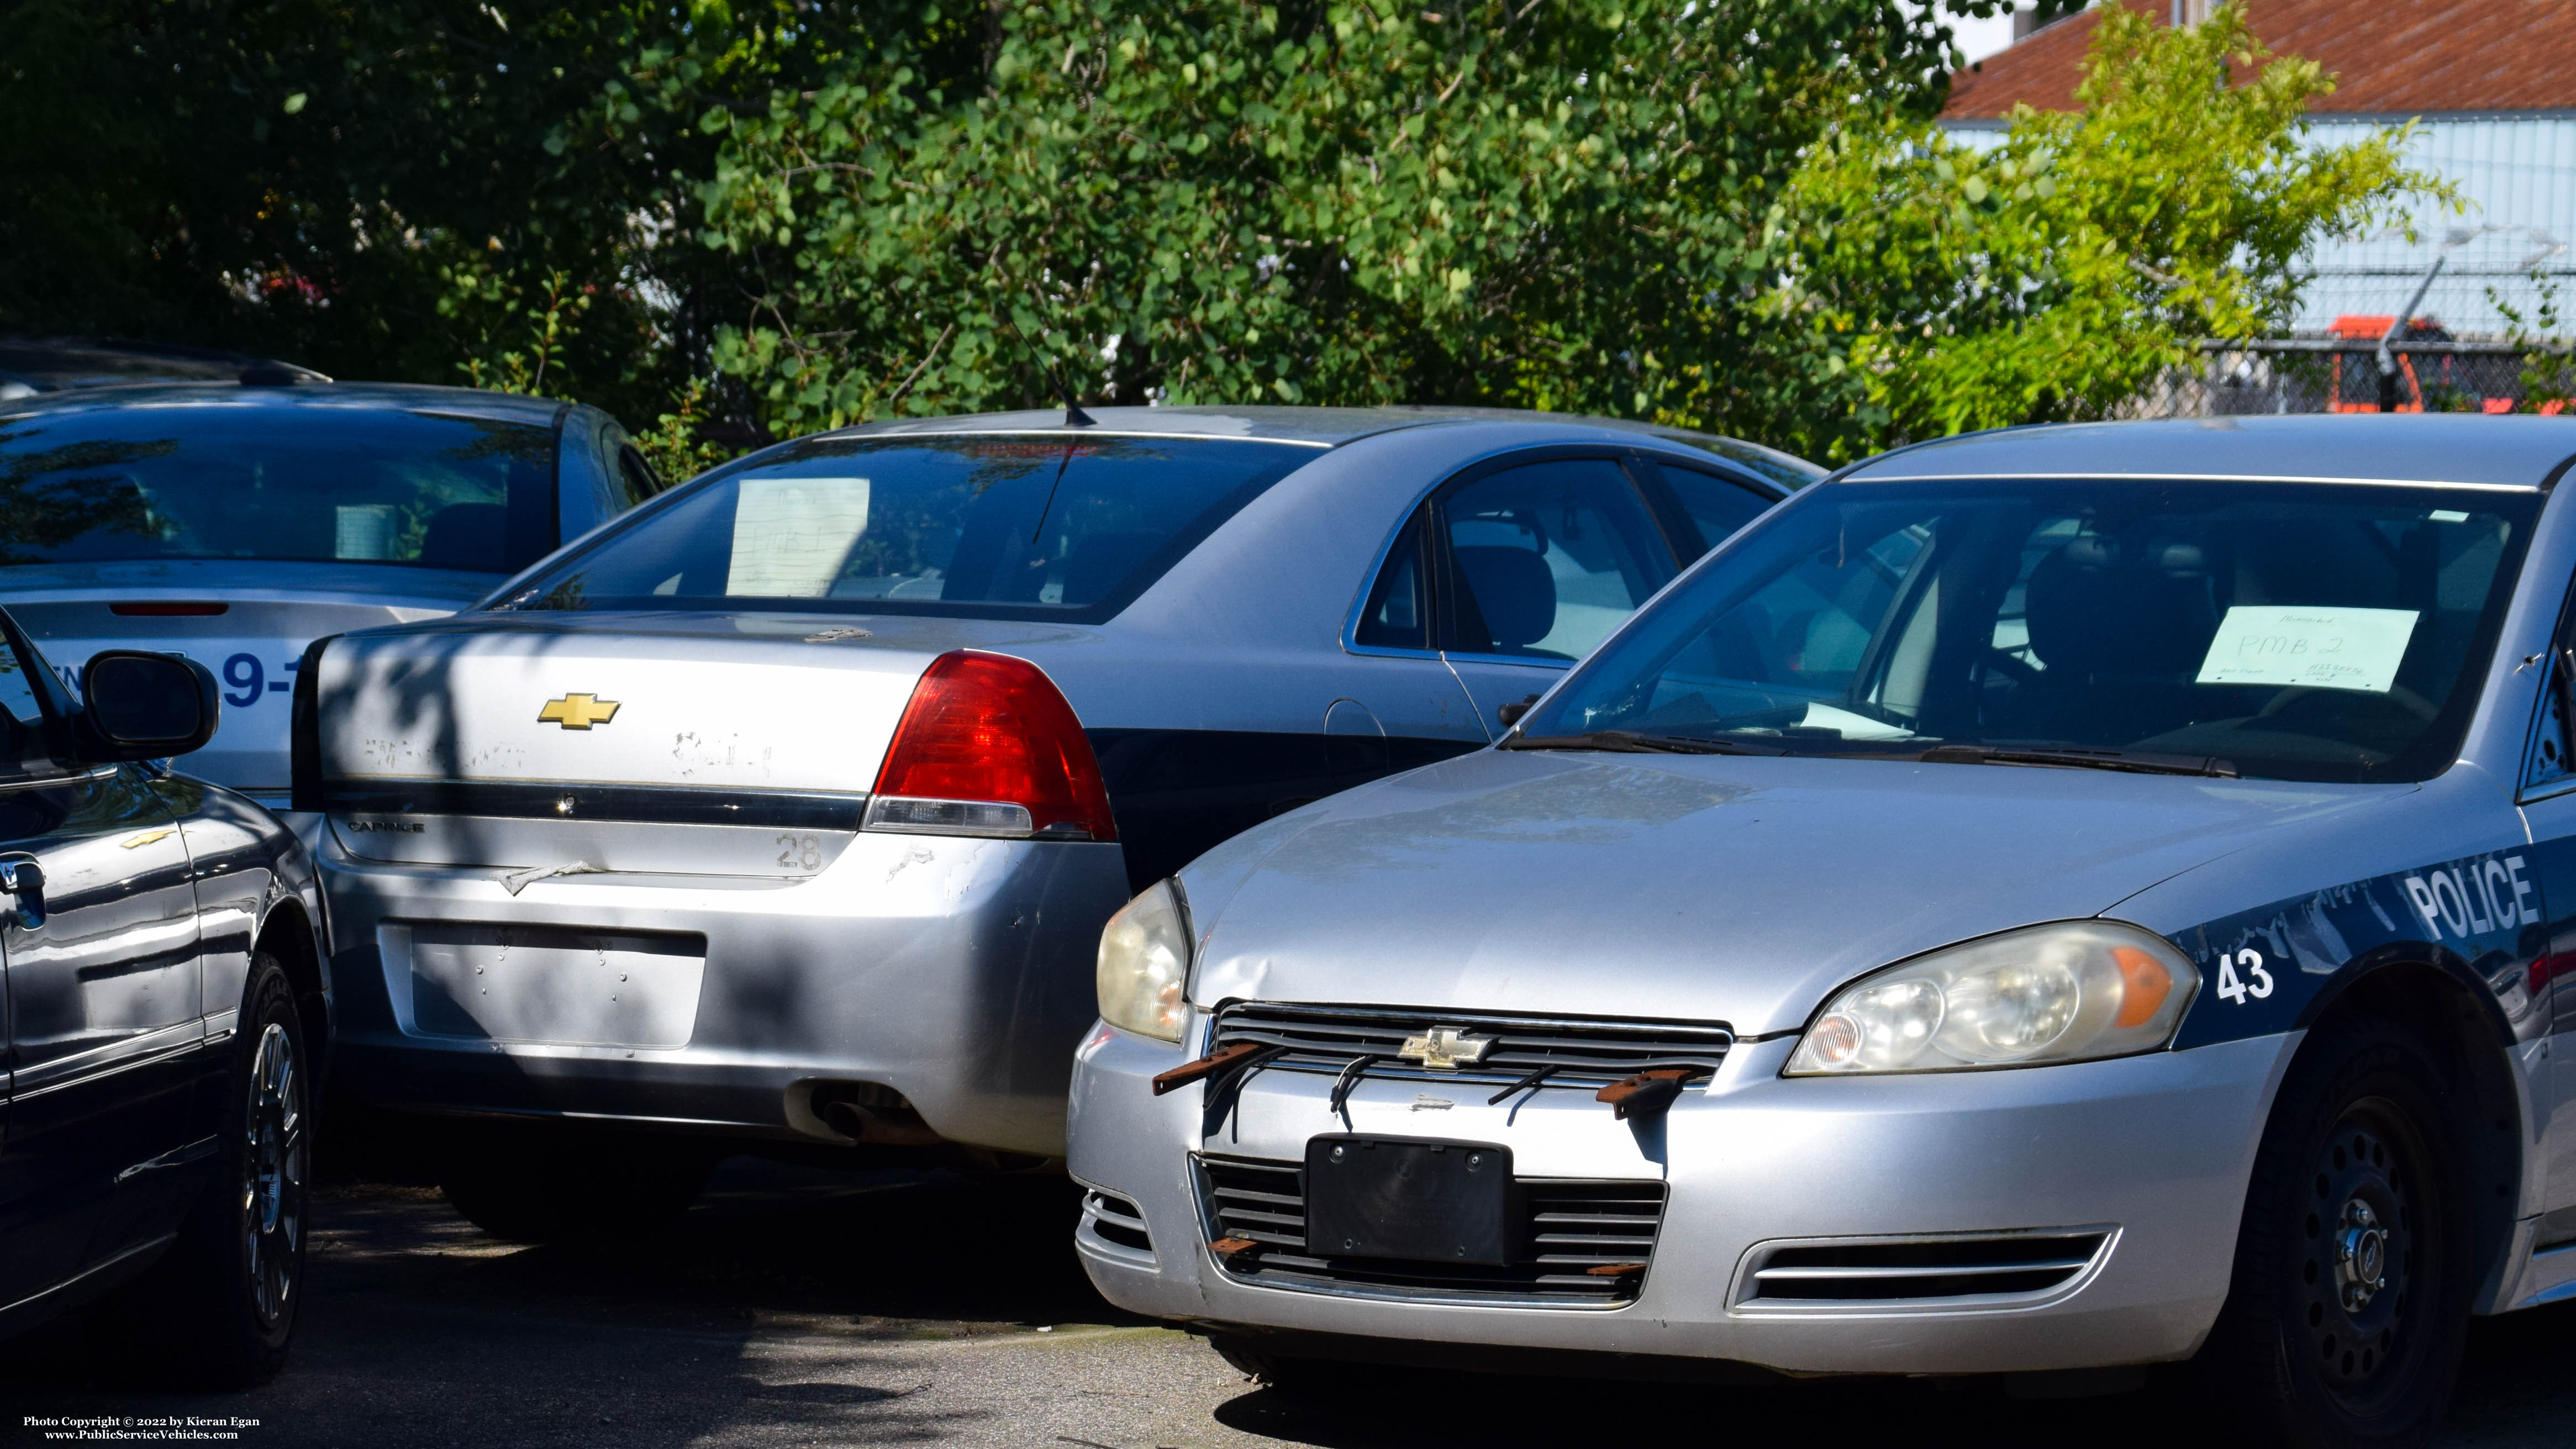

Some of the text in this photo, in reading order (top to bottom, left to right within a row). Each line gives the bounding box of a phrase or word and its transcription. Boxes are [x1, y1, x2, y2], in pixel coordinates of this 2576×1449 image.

[2238, 635, 2344, 656] PMB 2
[348, 821, 425, 833] CAPRICE
[776, 833, 821, 871] 28
[2404, 855, 2540, 940] POLICE
[2217, 948, 2274, 1005] 43
